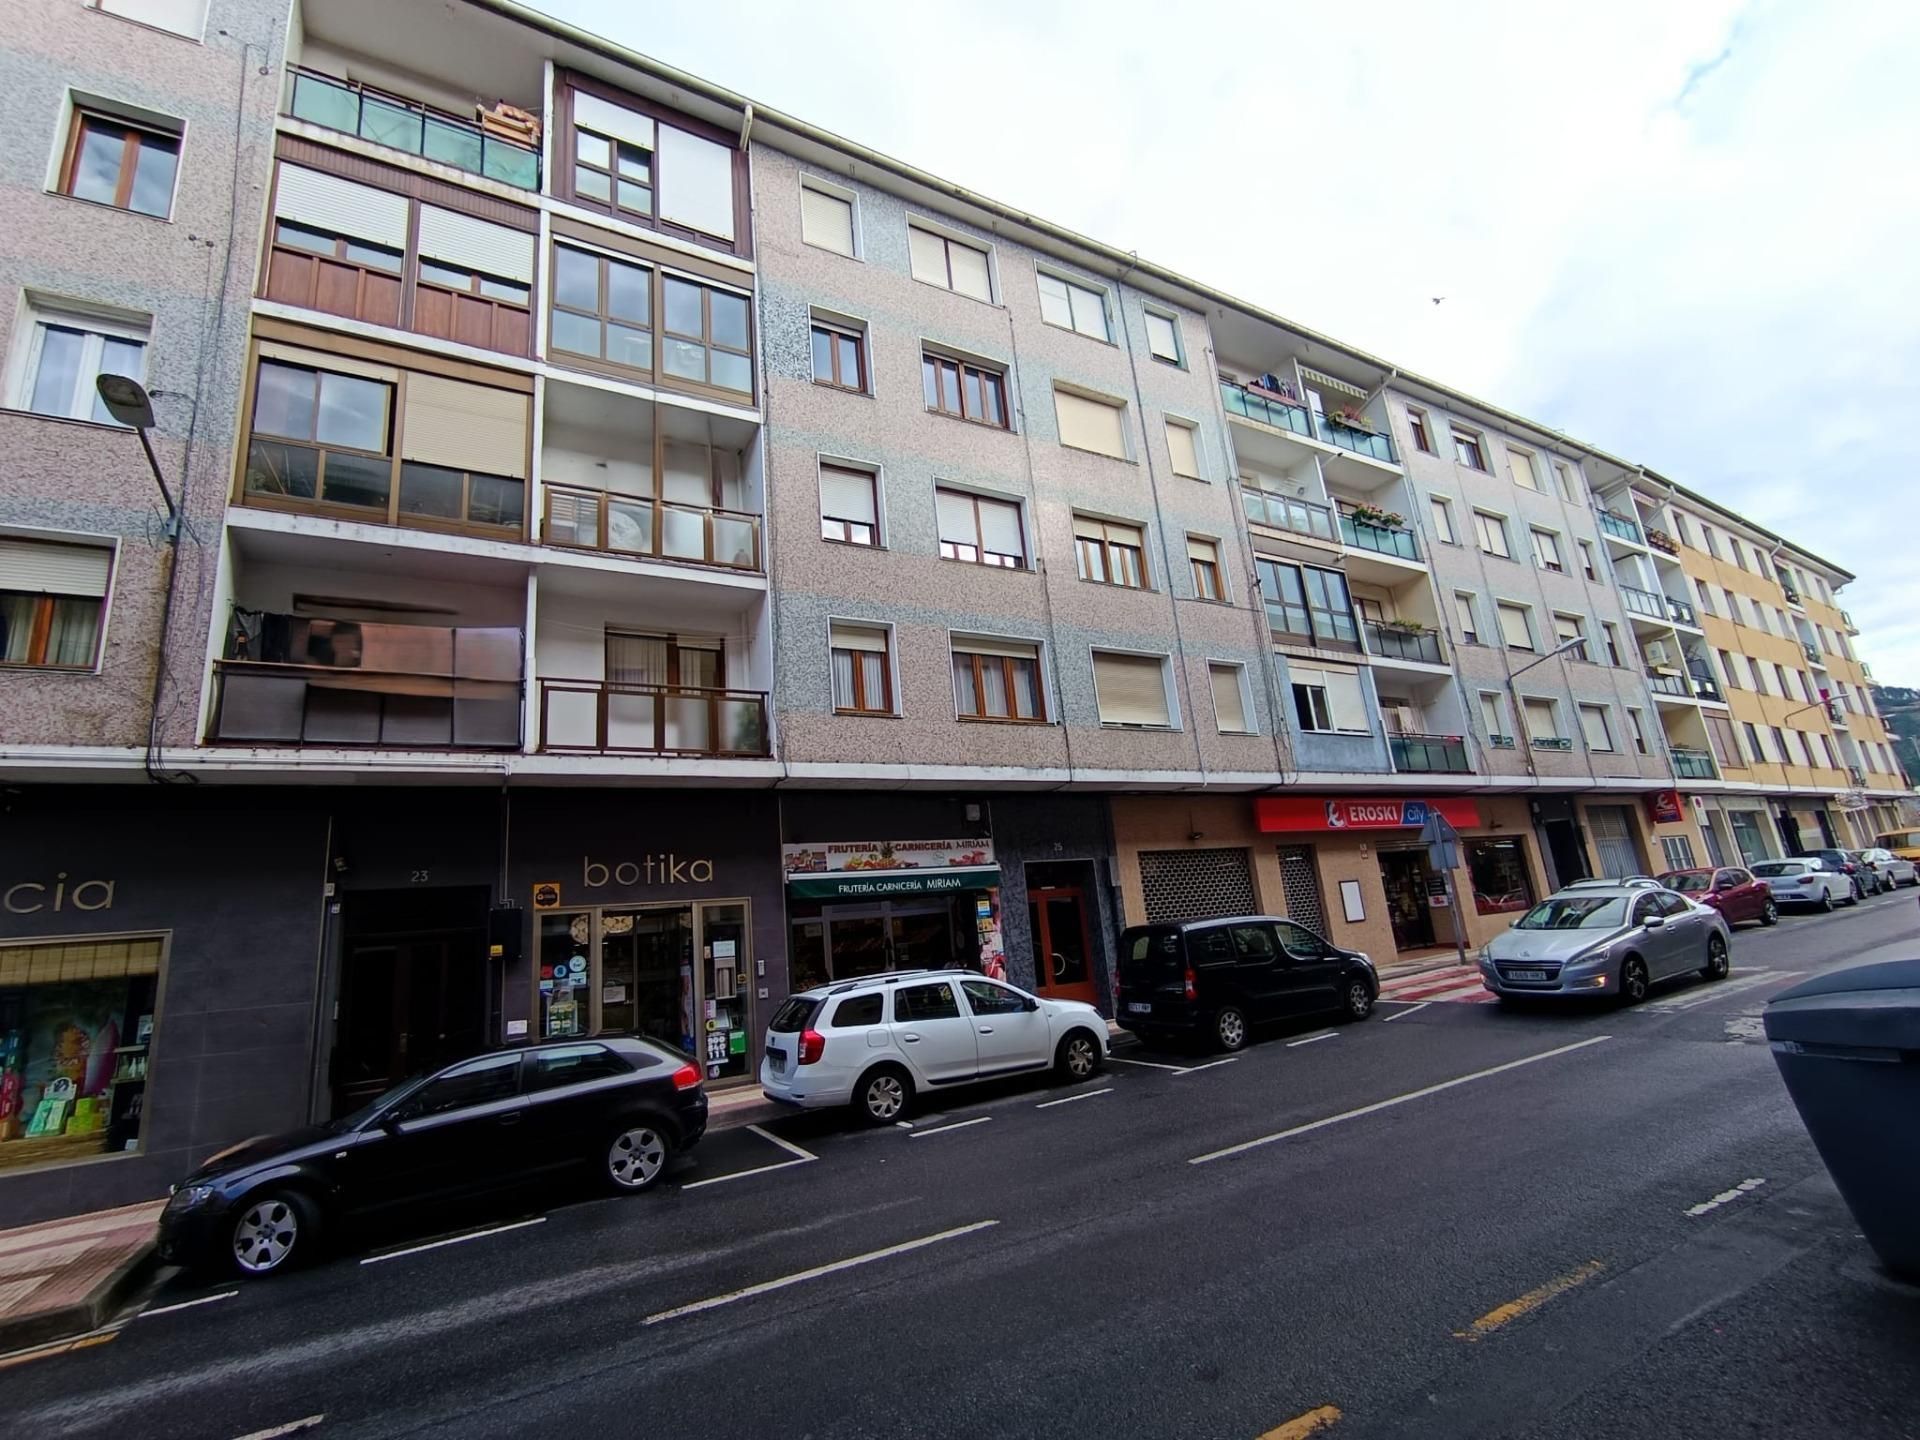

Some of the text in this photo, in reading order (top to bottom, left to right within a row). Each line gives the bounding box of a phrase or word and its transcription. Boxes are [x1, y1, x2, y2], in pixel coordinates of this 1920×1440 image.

[1349, 806, 1424, 823] EROSKI city
[828, 839, 990, 853] FRUTERÍA CARNICERÍA MIRIAM
[411, 870, 428, 882] 23
[584, 854, 713, 887] botika
[3, 872, 115, 914] cia
[838, 878, 962, 894] FRUTERÍA CARNICERÍA MIRIAM
